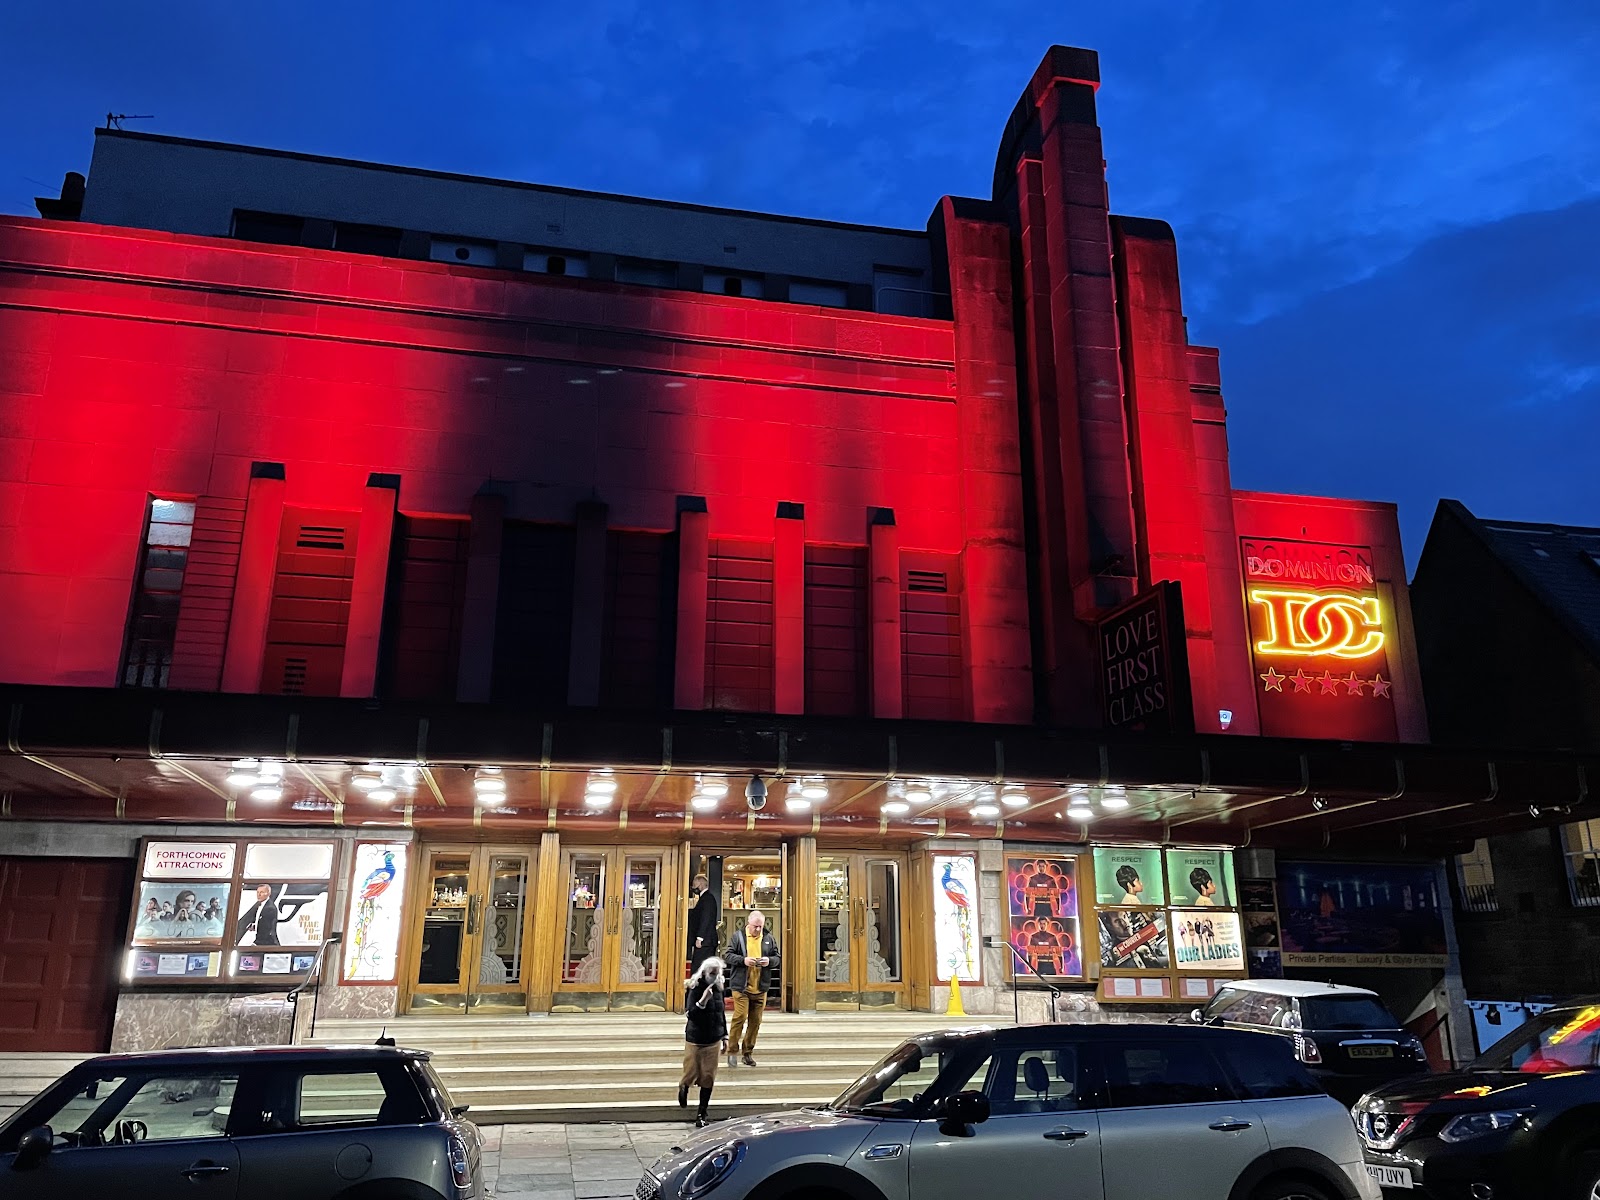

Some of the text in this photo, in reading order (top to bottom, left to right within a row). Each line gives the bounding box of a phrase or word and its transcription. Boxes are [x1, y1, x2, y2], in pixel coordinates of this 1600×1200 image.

[1247, 556, 1374, 584] DOMINION
[1104, 609, 1159, 662] LOVE
[1107, 644, 1161, 695] FIRST
[1109, 681, 1166, 726] CLASS
[156, 851, 226, 859] FORTHCOMING
[155, 861, 223, 869] ATTRACTIONS
[299, 914, 310, 922] NO
[1123, 932, 1142, 949] COURIER
[1177, 942, 1240, 963] OUR LADIES
[1288, 953, 1317, 963] Private
[1318, 954, 1347, 963] Parties
[1356, 955, 1382, 965] Luxury
[1385, 955, 1391, 964] &
[1414, 955, 1427, 964] For
[1385, 1168, 1405, 1185] UVY
